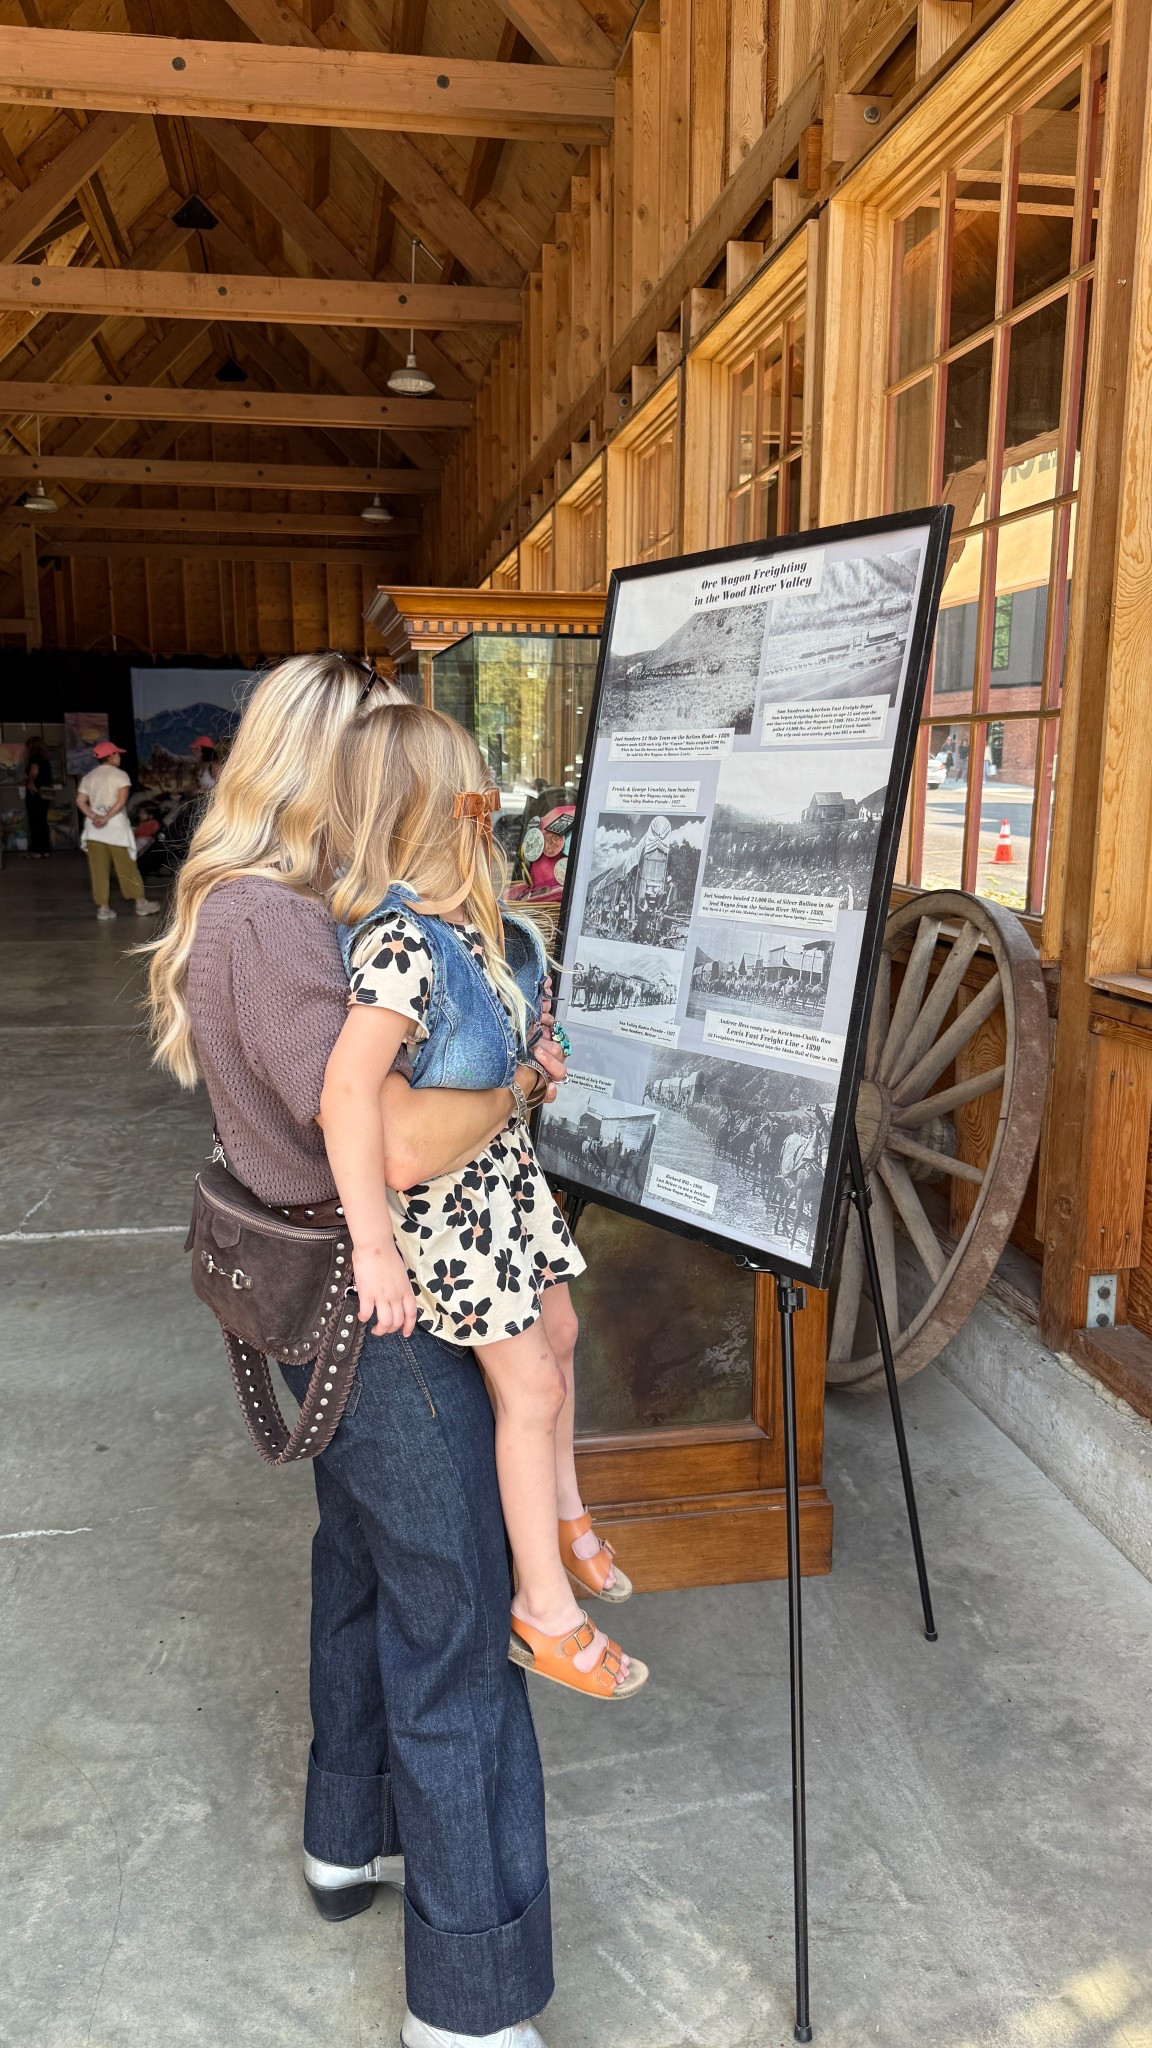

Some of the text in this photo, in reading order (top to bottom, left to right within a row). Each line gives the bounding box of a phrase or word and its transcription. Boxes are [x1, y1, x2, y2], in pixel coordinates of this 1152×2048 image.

[702, 562, 808, 590] Ore Wagon Freighting
[706, 594, 720, 604] the
[723, 587, 747, 600] Wood
[749, 584, 777, 596] River
[781, 576, 812, 590] Valley
[727, 1028, 744, 1037] Lewis
[760, 1034, 784, 1045] Freight
[785, 1039, 800, 1048] Line
